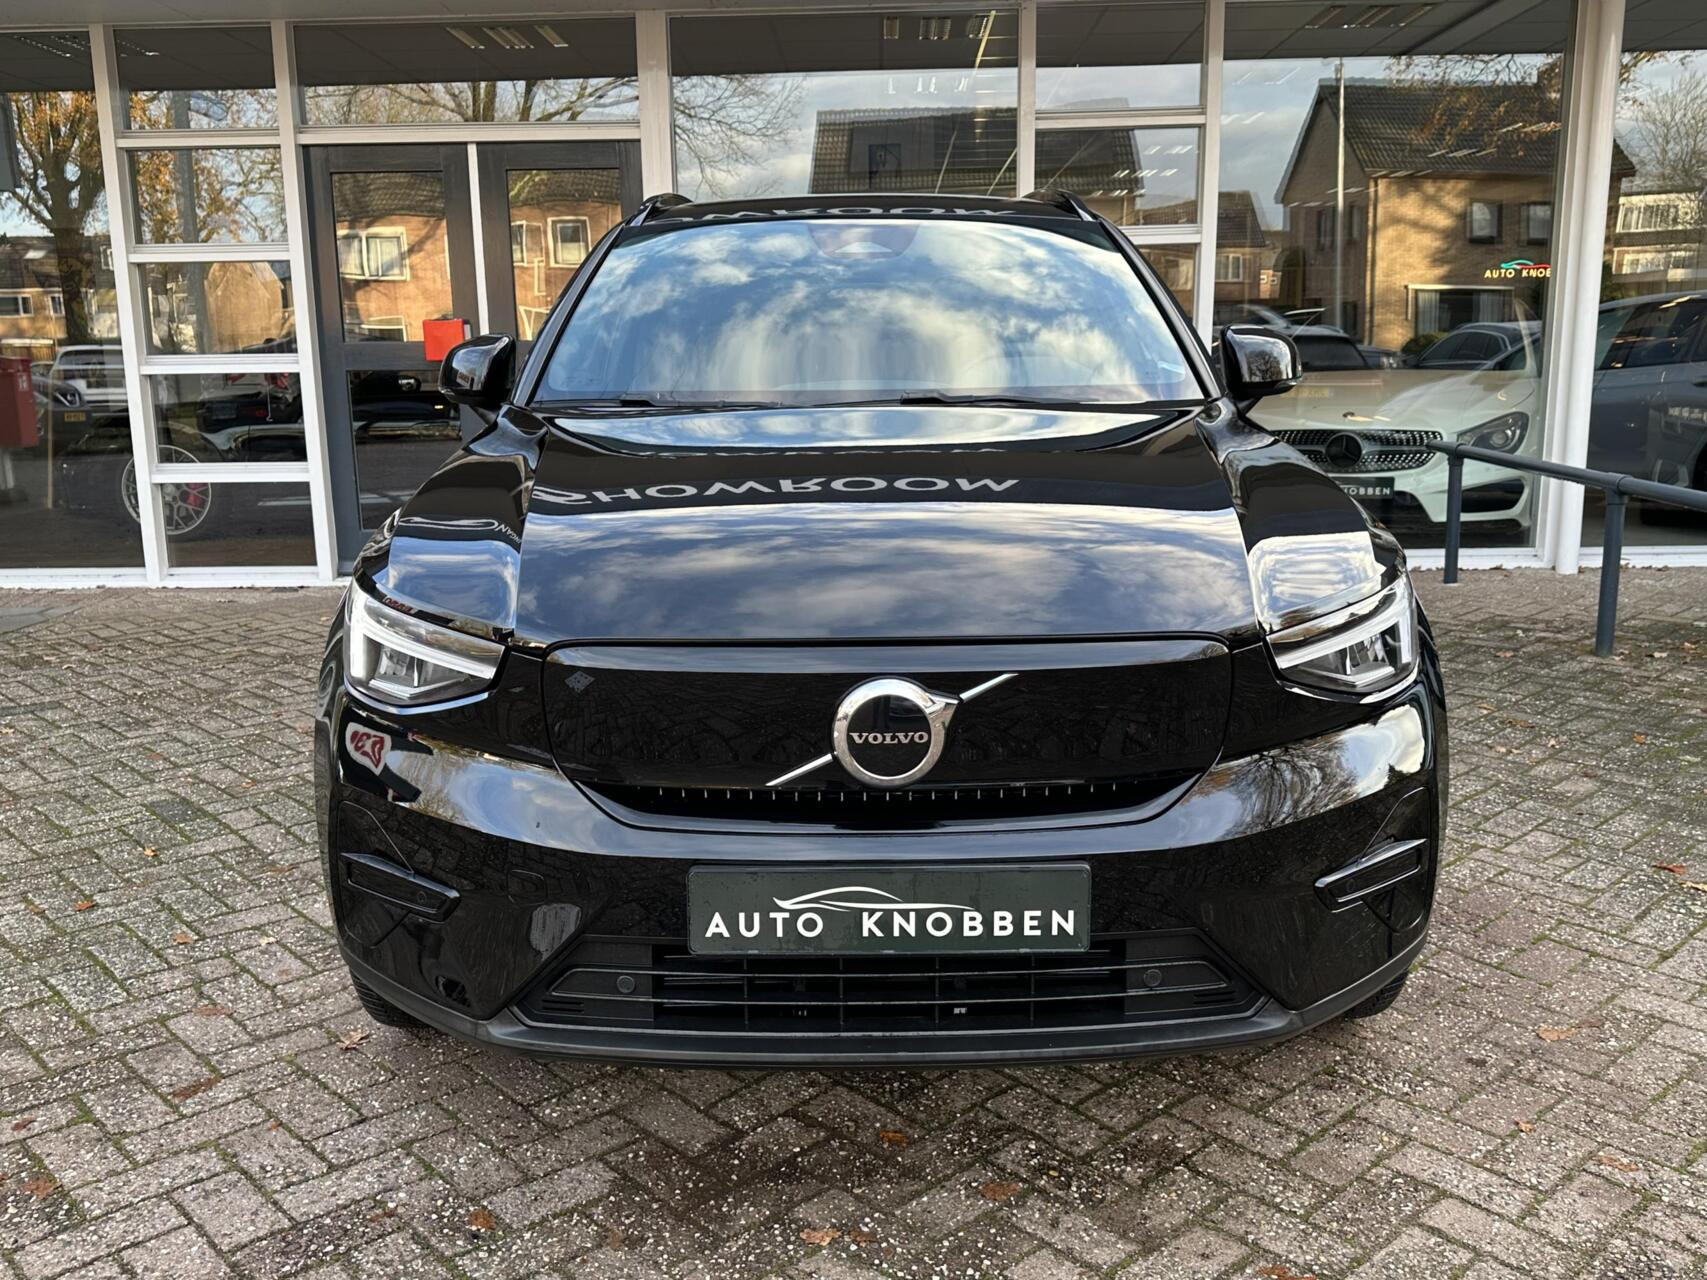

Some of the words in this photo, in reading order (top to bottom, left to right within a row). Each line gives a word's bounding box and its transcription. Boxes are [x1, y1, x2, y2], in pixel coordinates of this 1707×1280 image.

[1484, 269, 1516, 278] AUTO
[849, 731, 929, 744] VOLVO
[704, 911, 824, 938] AUTO
[861, 909, 1075, 937] KNOBBEN
